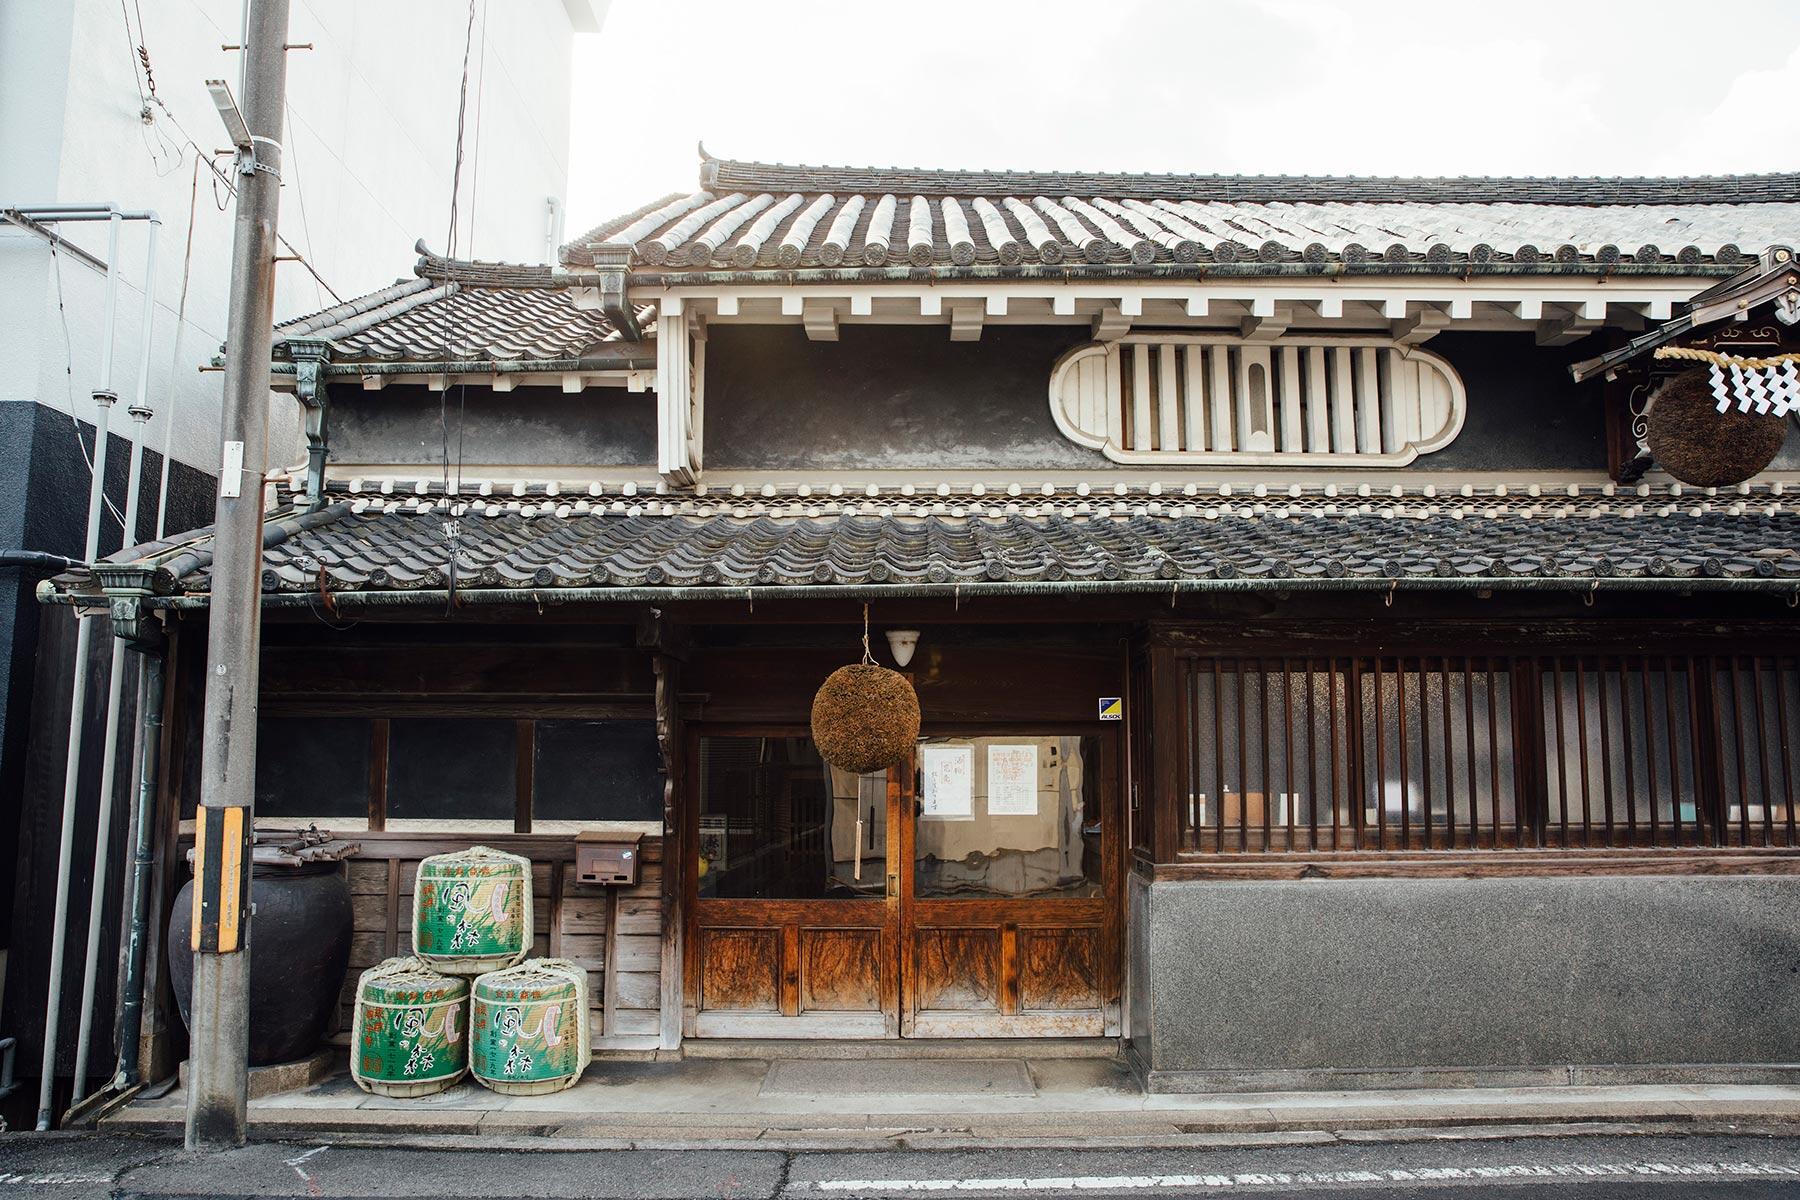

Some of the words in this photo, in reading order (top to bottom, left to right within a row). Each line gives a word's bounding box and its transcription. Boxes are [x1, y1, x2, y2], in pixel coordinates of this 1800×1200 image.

[442, 882, 488, 949] 風の森
[394, 1007, 445, 1075] 風の森
[494, 1006, 542, 1074] 風の森
